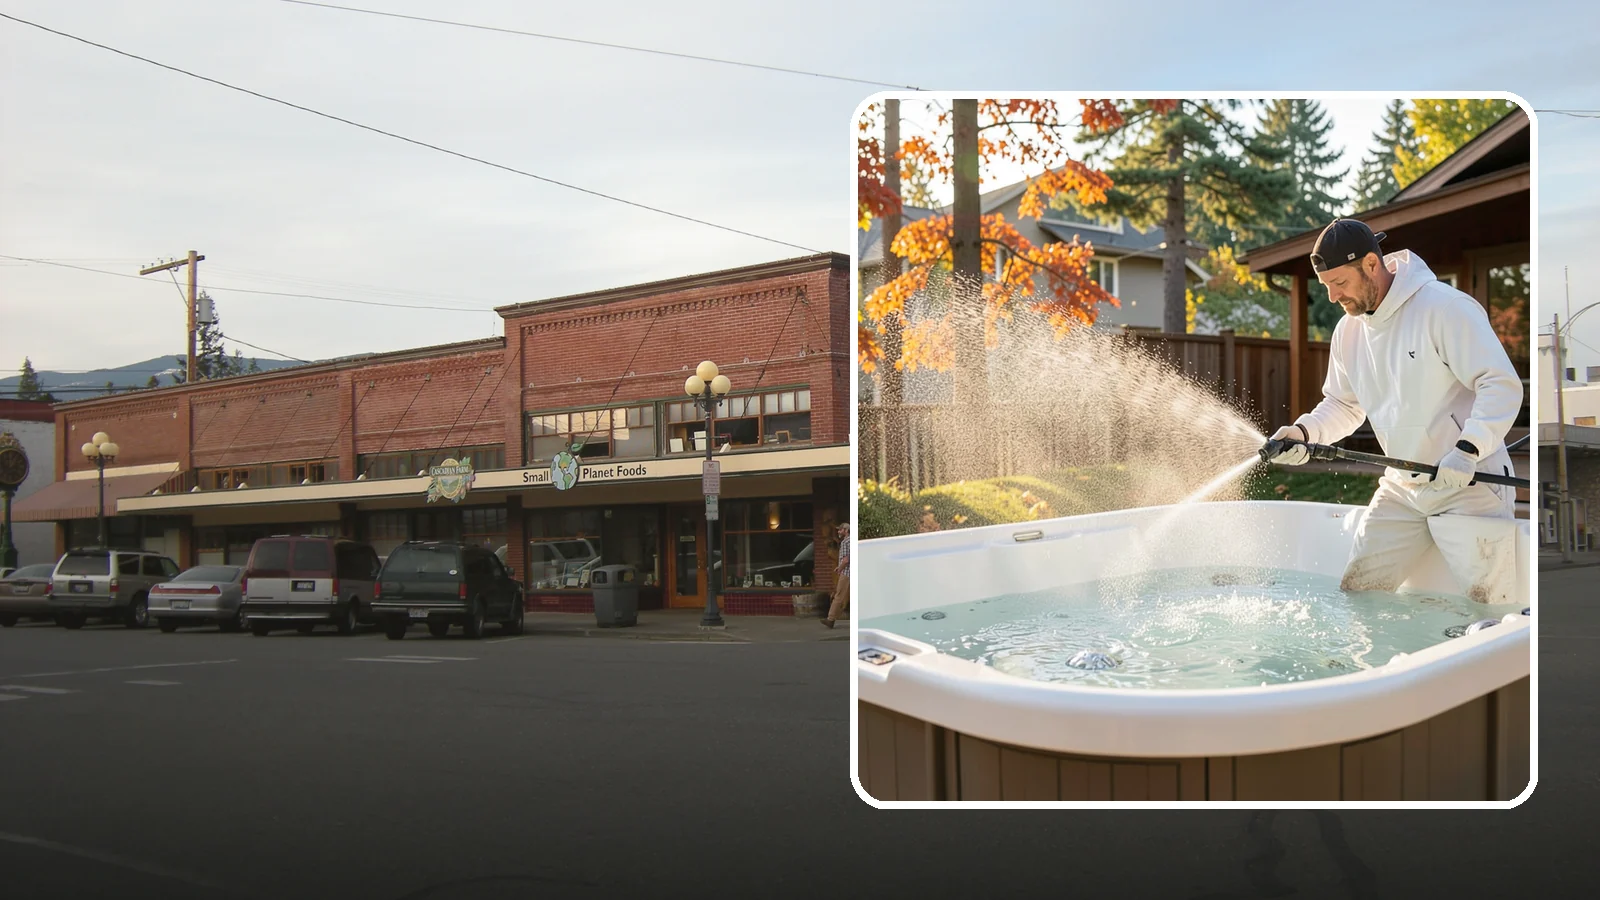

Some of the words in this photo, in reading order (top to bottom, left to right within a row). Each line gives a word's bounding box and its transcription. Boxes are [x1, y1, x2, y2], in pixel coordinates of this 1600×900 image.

[456, 466, 469, 474] FARM
[522, 471, 549, 483] Small
[582, 467, 614, 479] Planet
[616, 464, 647, 477] Foods
